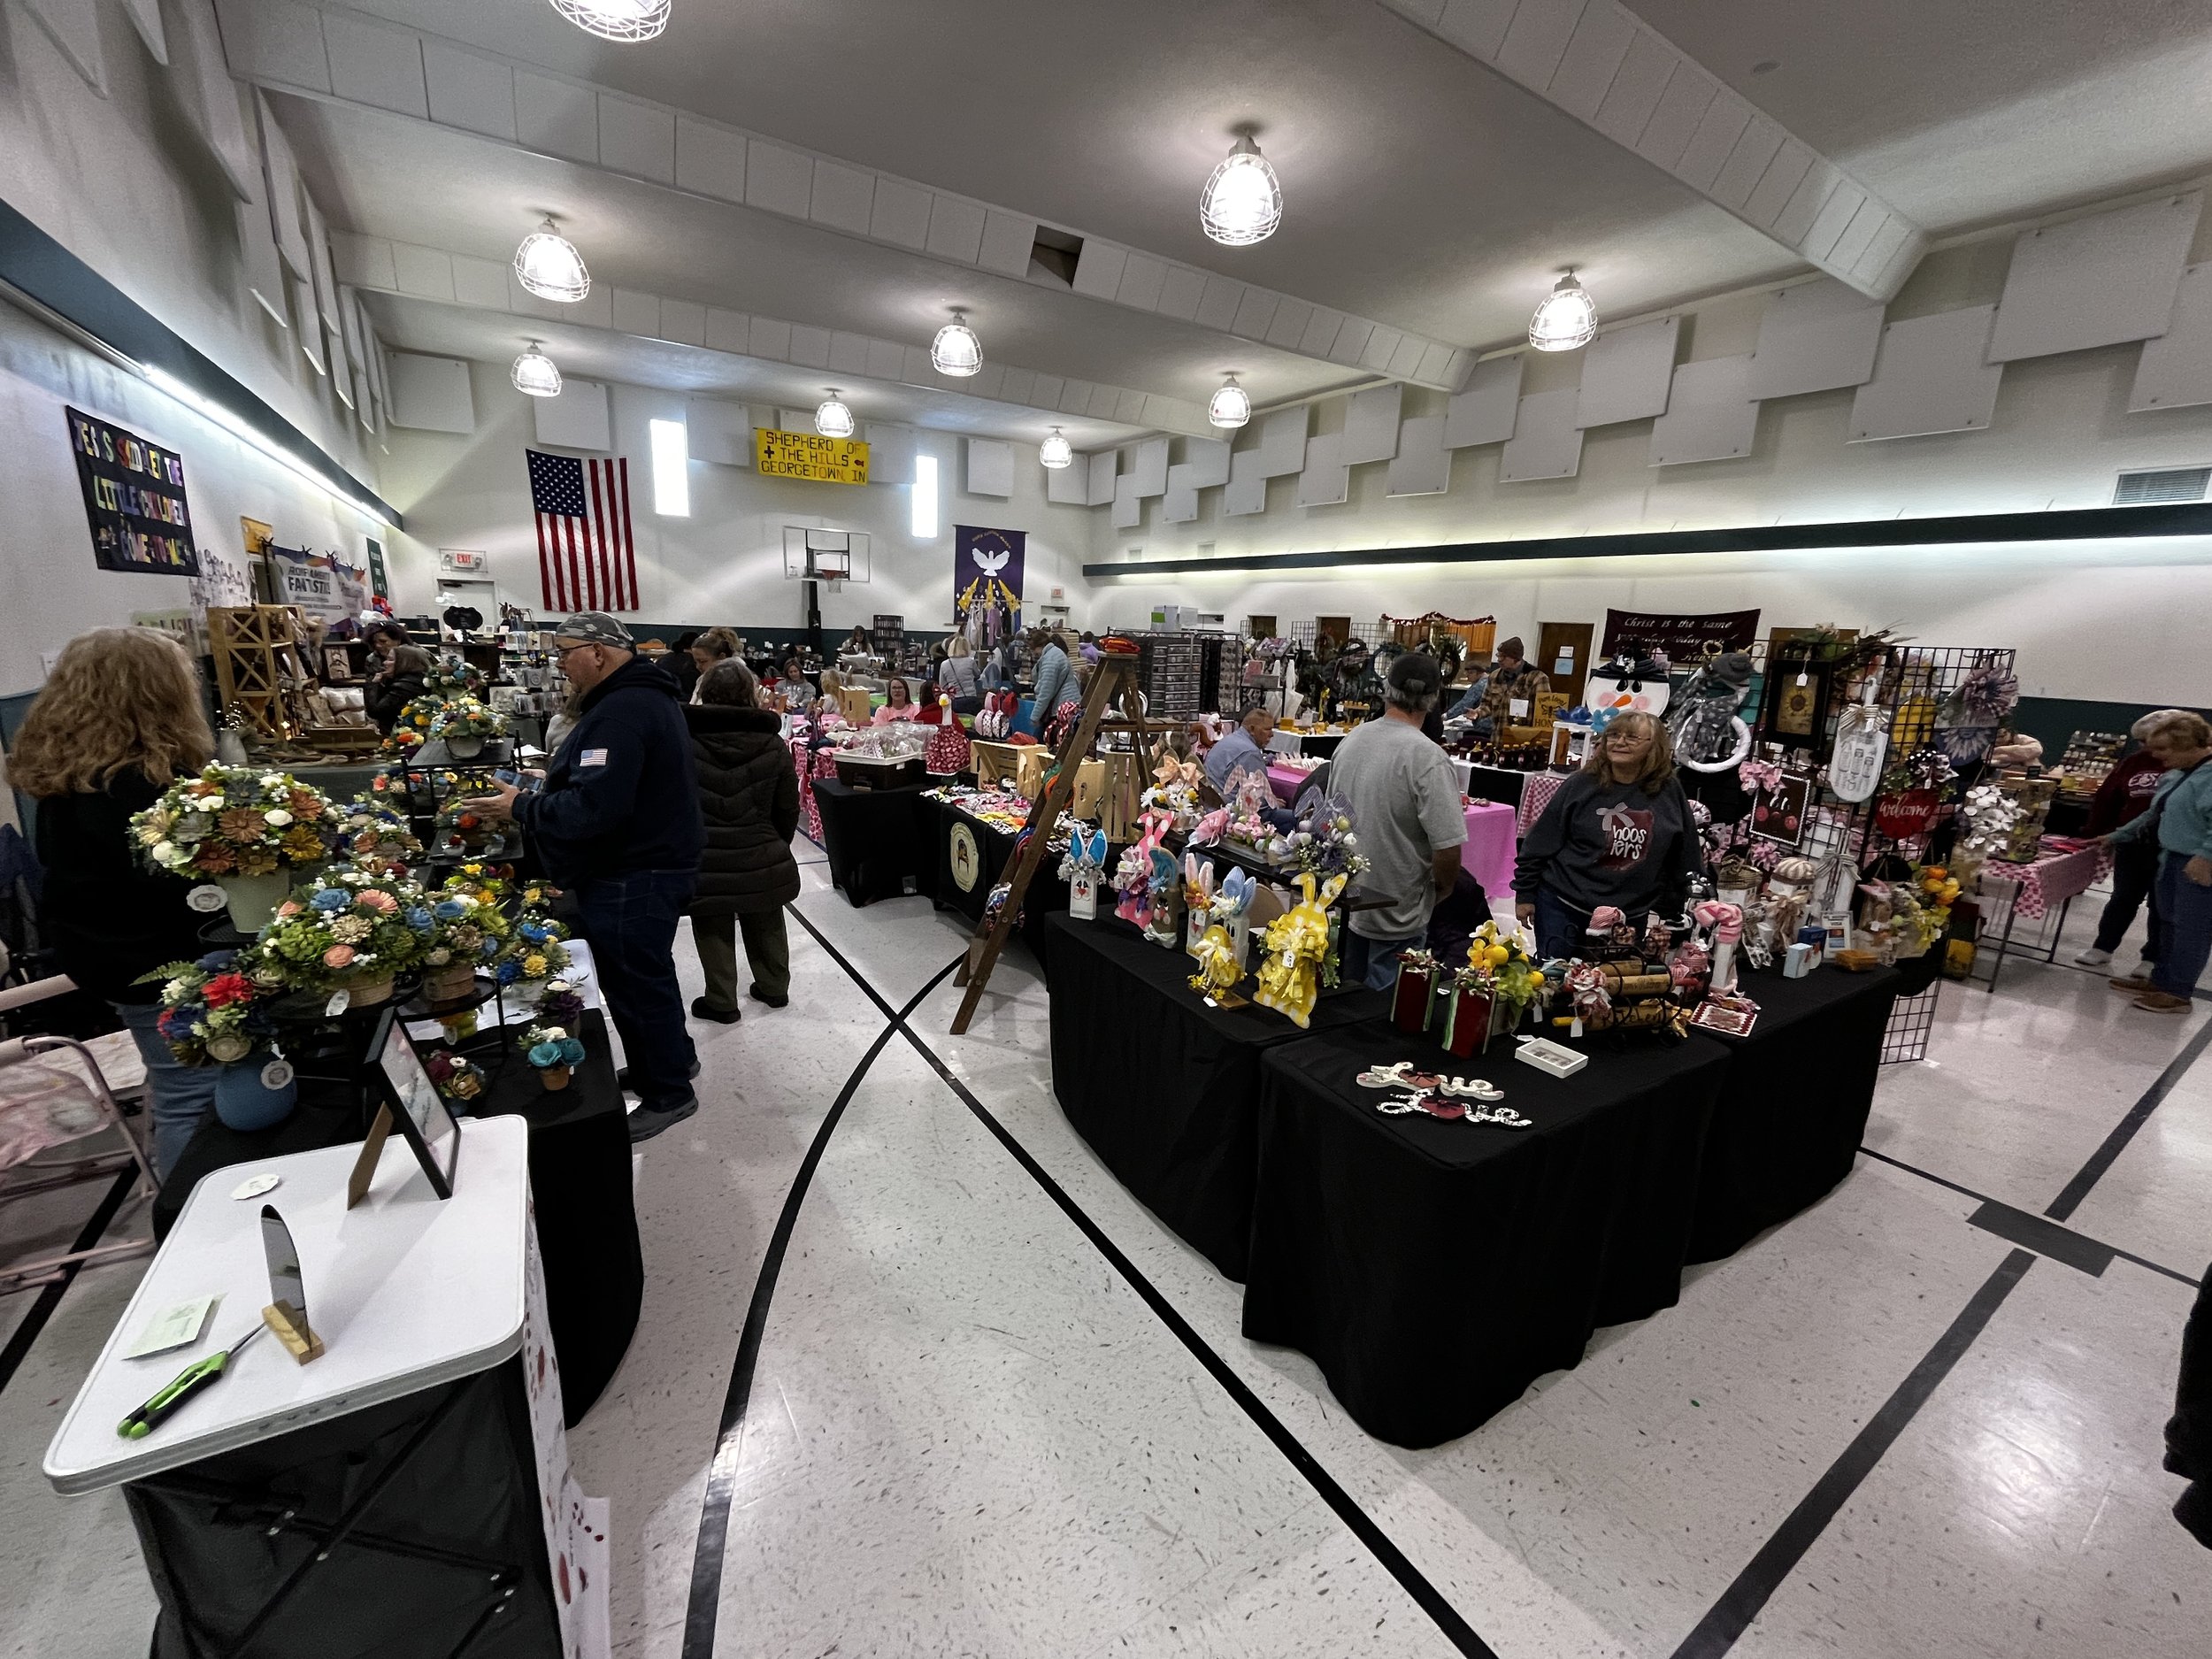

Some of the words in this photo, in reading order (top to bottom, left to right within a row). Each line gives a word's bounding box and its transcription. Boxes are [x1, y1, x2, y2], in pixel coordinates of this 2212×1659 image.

[766, 432, 833, 452] SHEPHERD
[847, 442, 861, 455] OF
[780, 447, 804, 462] THE
[810, 450, 849, 467] HILLS
[761, 460, 845, 481] GEORGETOWN
[852, 470, 865, 483] IN
[457, 553, 472, 564] EXIT
[1624, 618, 1655, 627] Christ
[1678, 618, 1694, 628] the
[1702, 620, 1732, 629] same
[1535, 718, 1555, 728] HON
[1879, 794, 1931, 818] welcome
[1612, 825, 1647, 843] hoos
